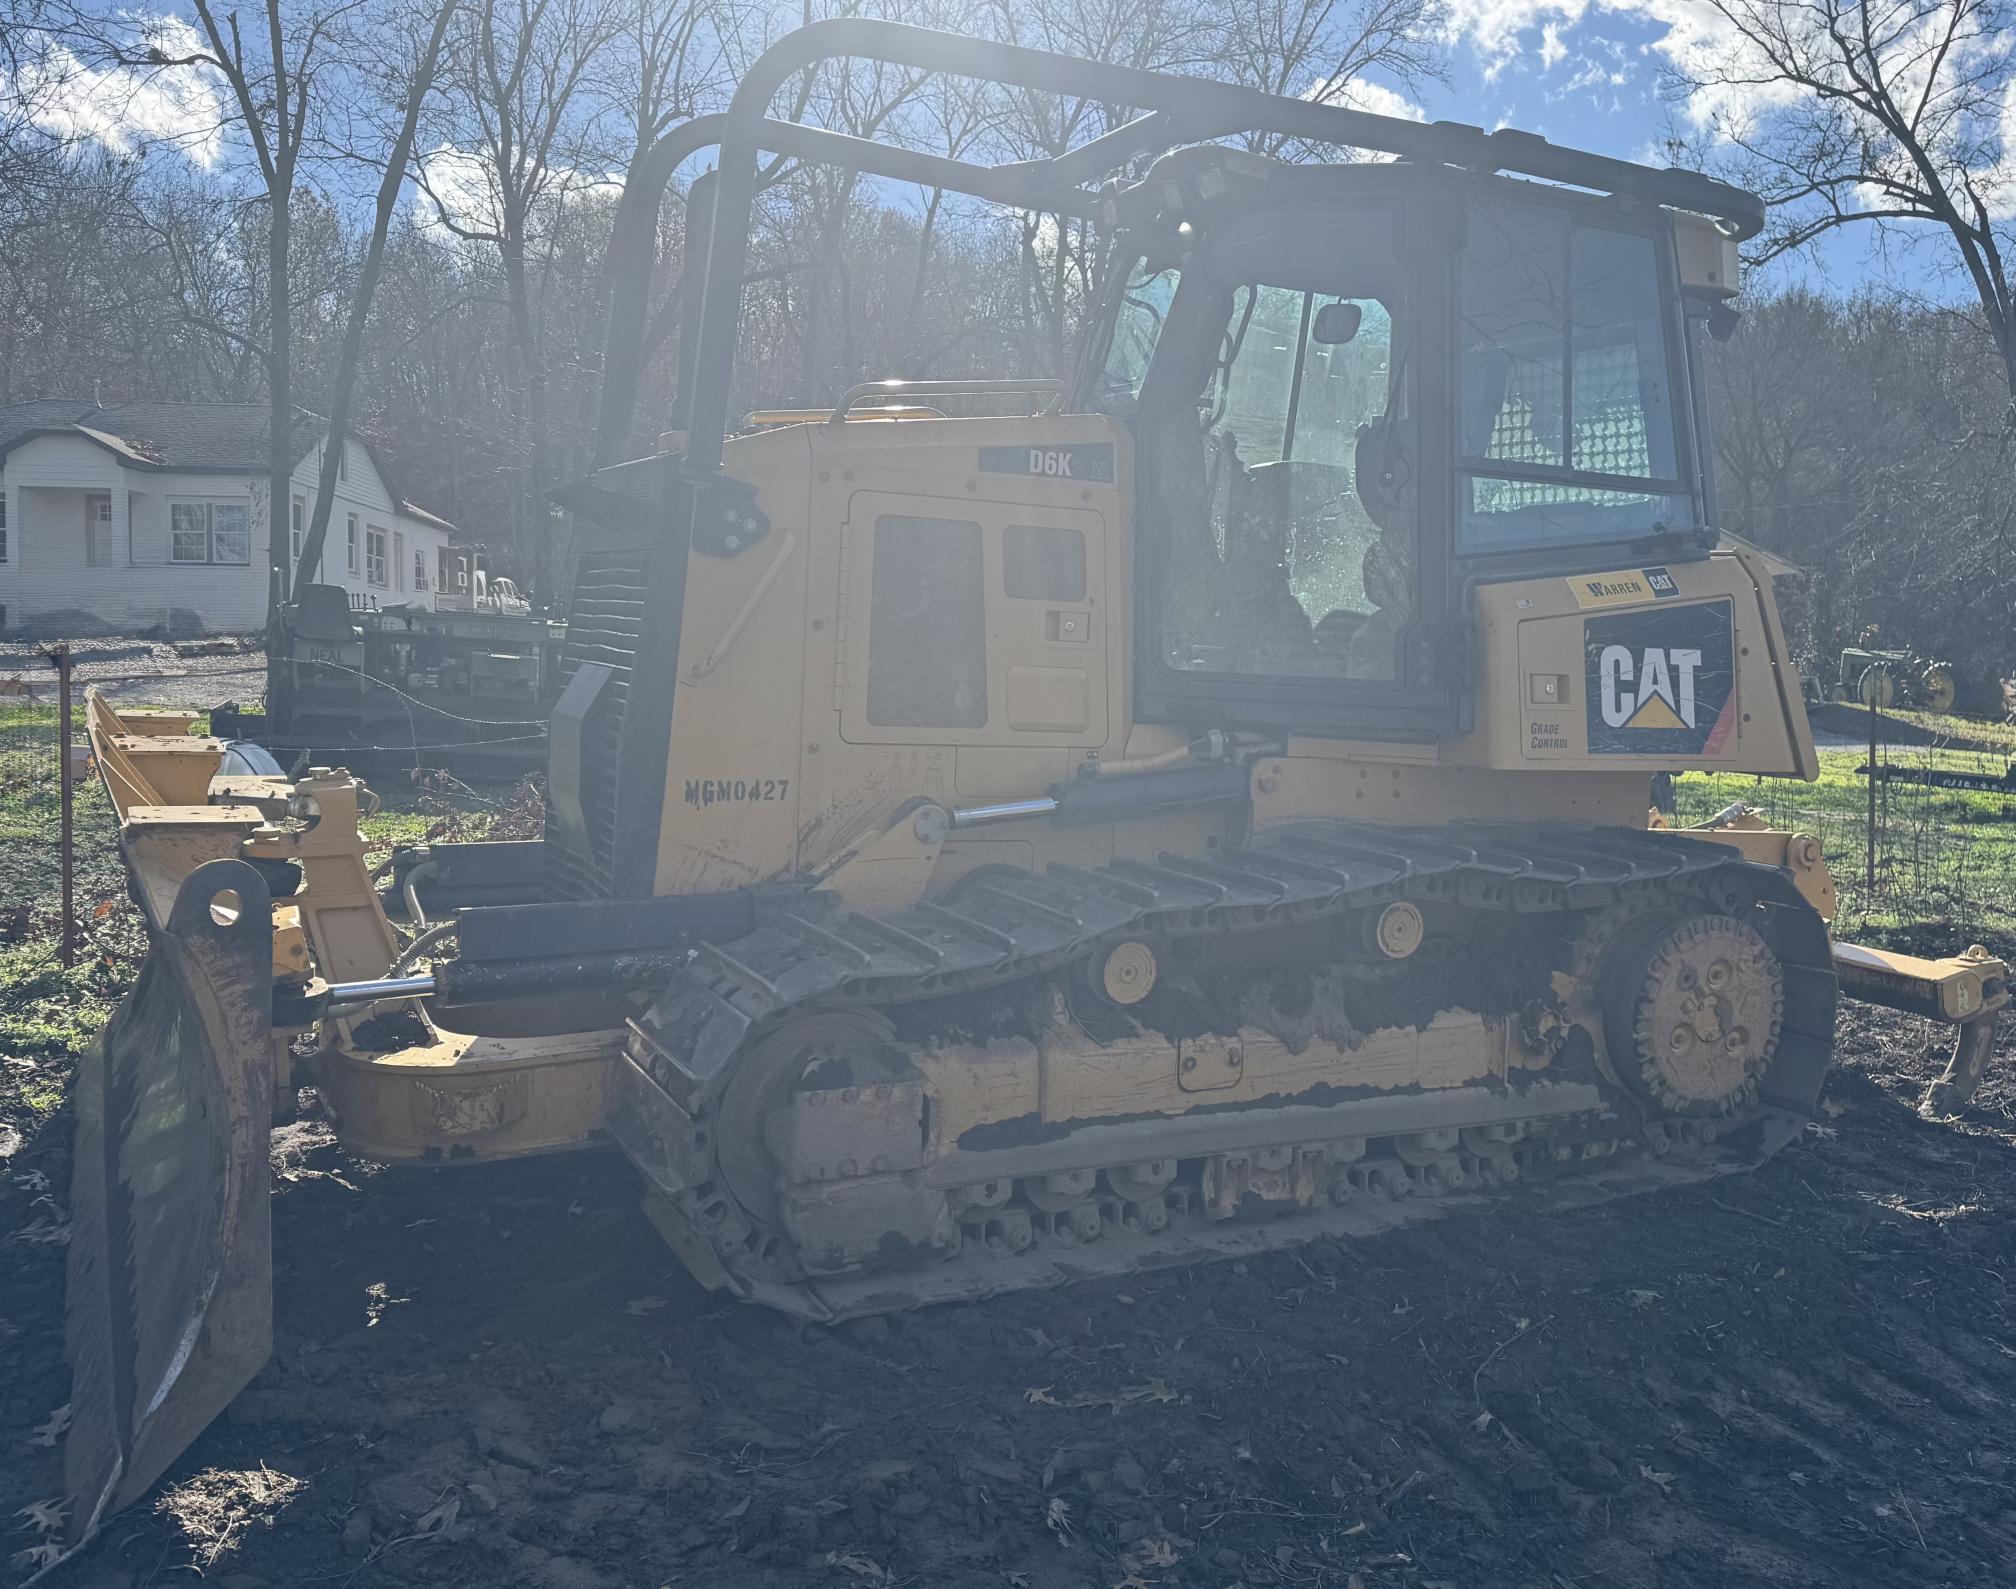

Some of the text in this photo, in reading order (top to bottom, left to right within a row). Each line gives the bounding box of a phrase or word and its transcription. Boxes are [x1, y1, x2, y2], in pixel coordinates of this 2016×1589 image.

[1586, 573, 1673, 597] WARREN CAT
[1600, 645, 1702, 728] CAT
[1531, 722, 1559, 735] GRADE
[1531, 737, 1568, 750] CONTROL
[685, 780, 789, 804] MGM0427
